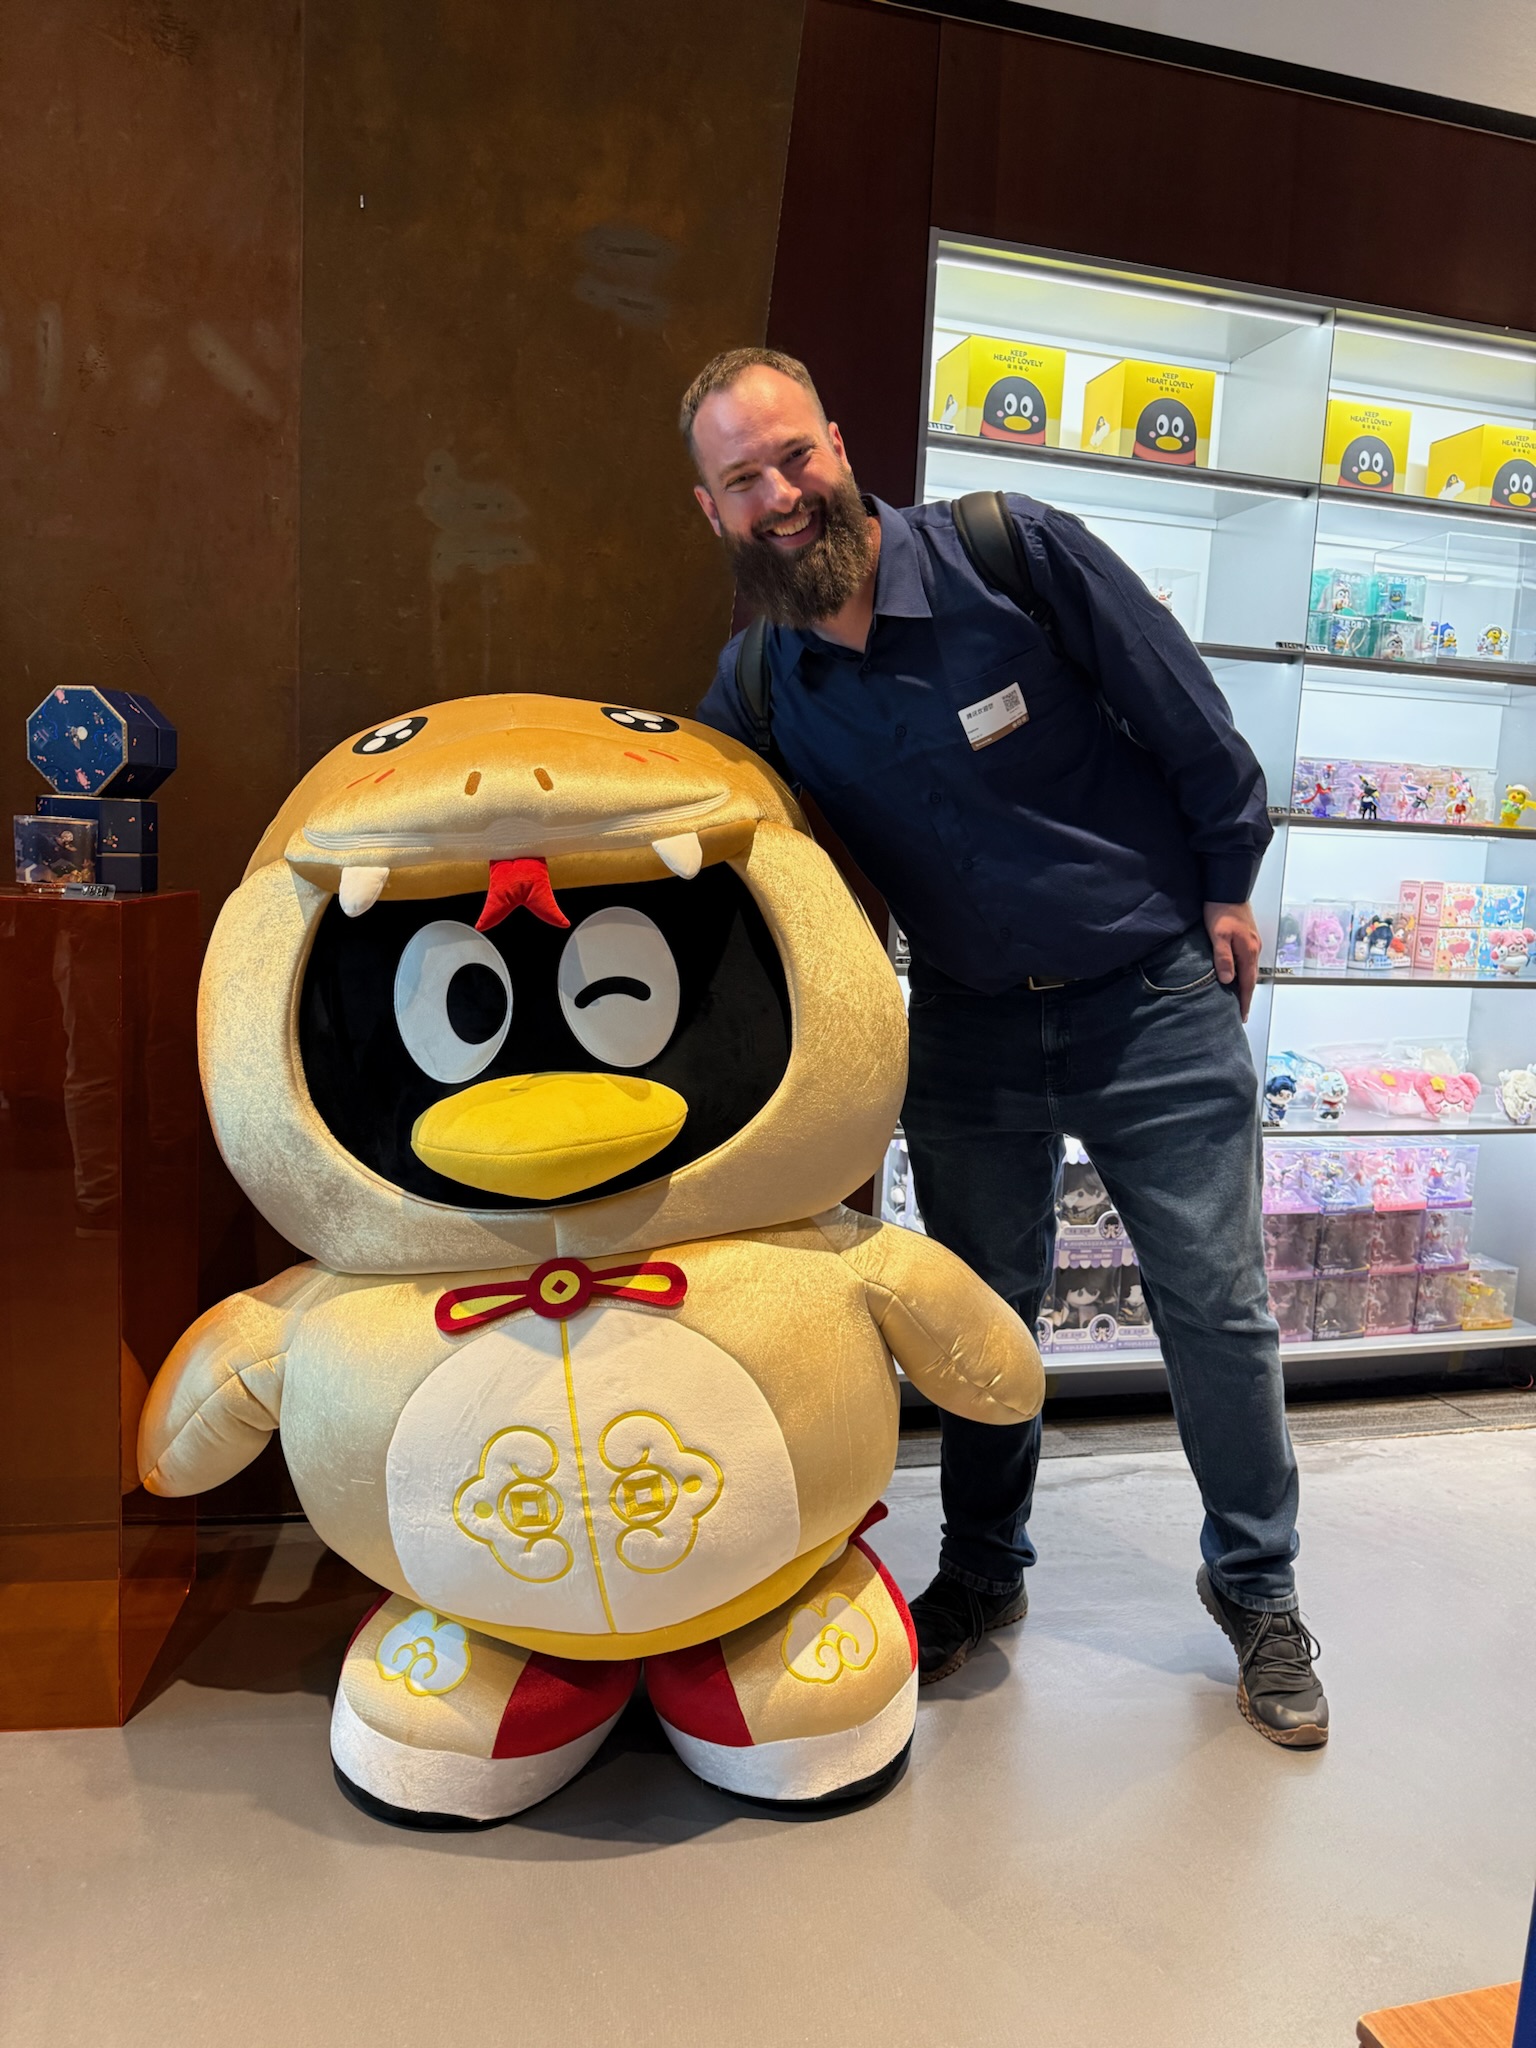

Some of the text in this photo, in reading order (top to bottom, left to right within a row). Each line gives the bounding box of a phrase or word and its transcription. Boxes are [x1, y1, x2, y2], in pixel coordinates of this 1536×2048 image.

[1010, 349, 1027, 358] KEEP
[993, 354, 1043, 367] HEART LOVELY
[1162, 372, 1178, 380] KEEP
[1146, 377, 1194, 389] HEART LOVELY
[1350, 416, 1392, 426] HEART LOVELY
